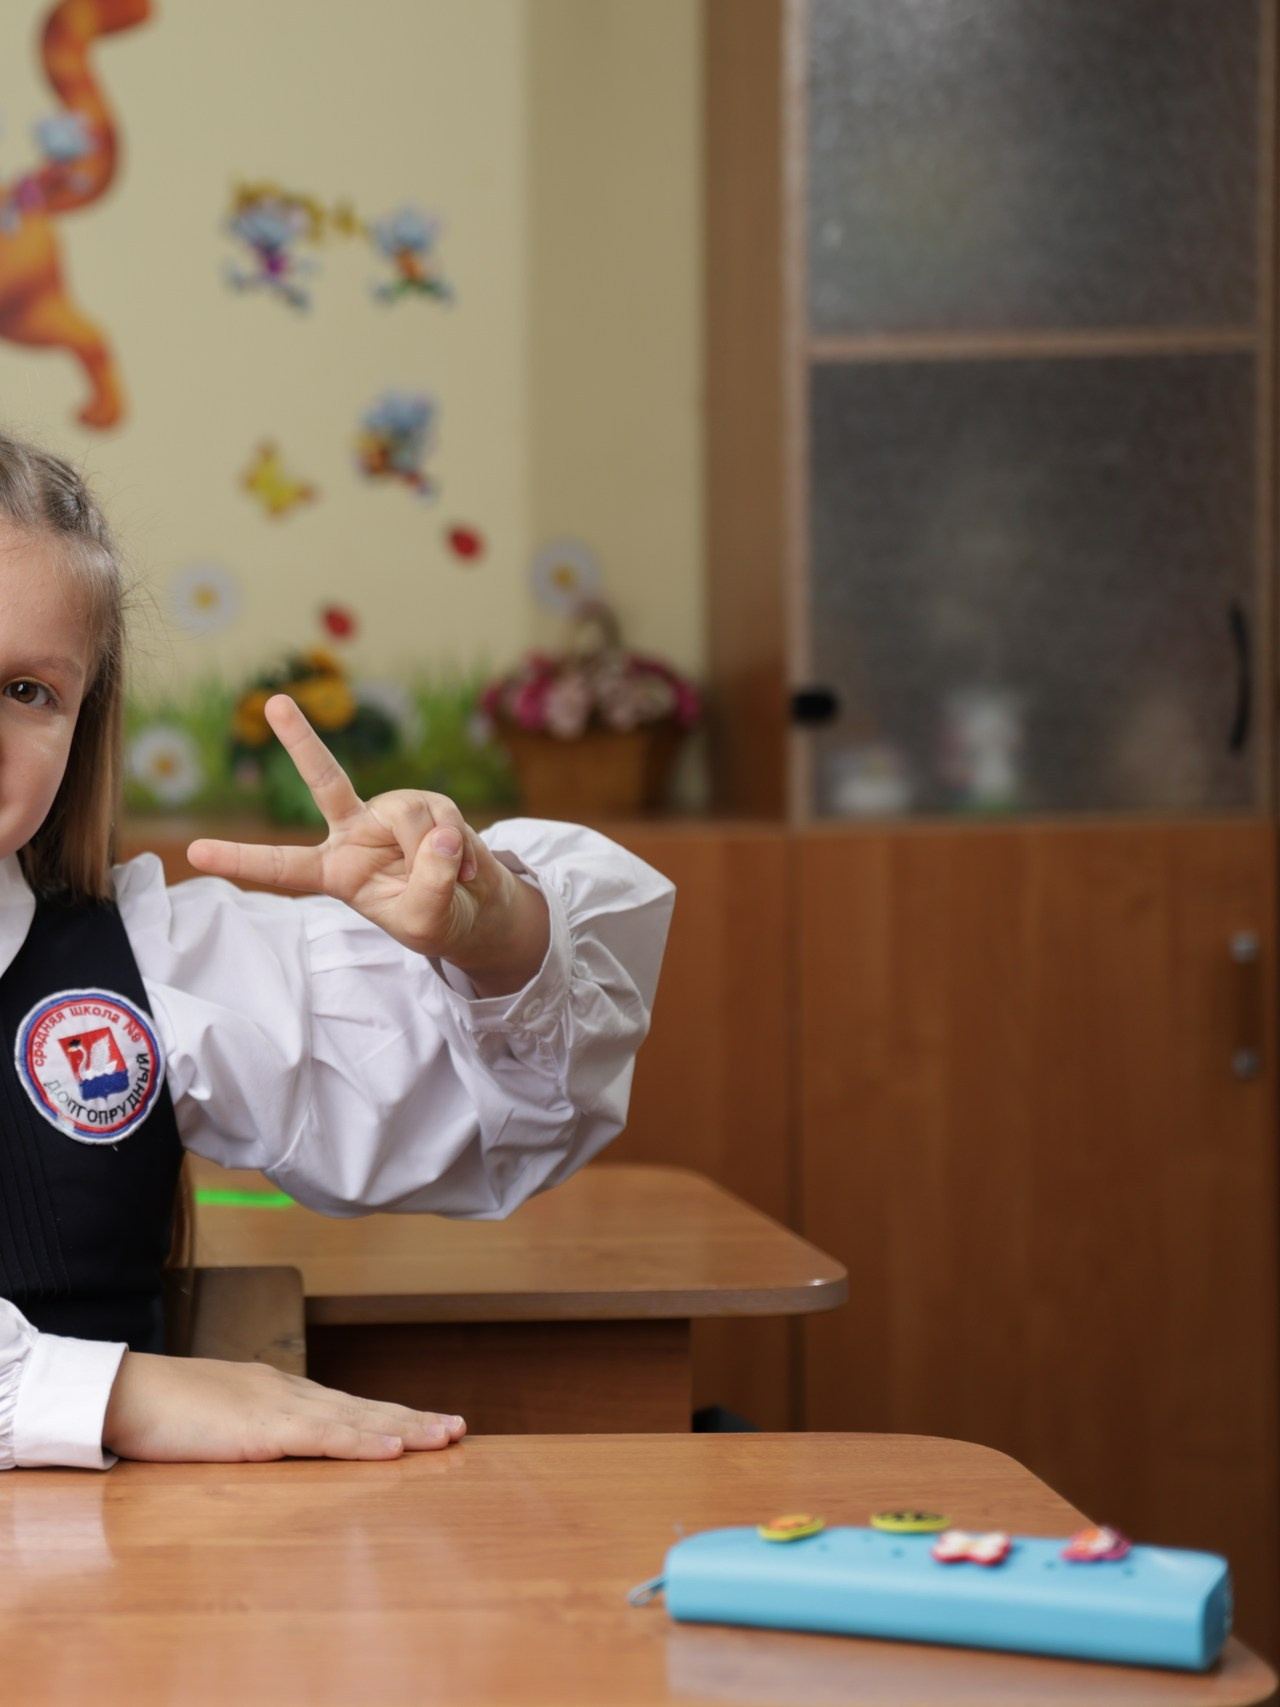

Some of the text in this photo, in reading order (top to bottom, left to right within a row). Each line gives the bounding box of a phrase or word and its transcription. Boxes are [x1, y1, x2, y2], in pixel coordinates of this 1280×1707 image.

[32, 1011, 66, 1067] средняя
[70, 1006, 120, 1023] школа
[44, 1053, 150, 1124] ДОЛГОПРУДНЫЙ
